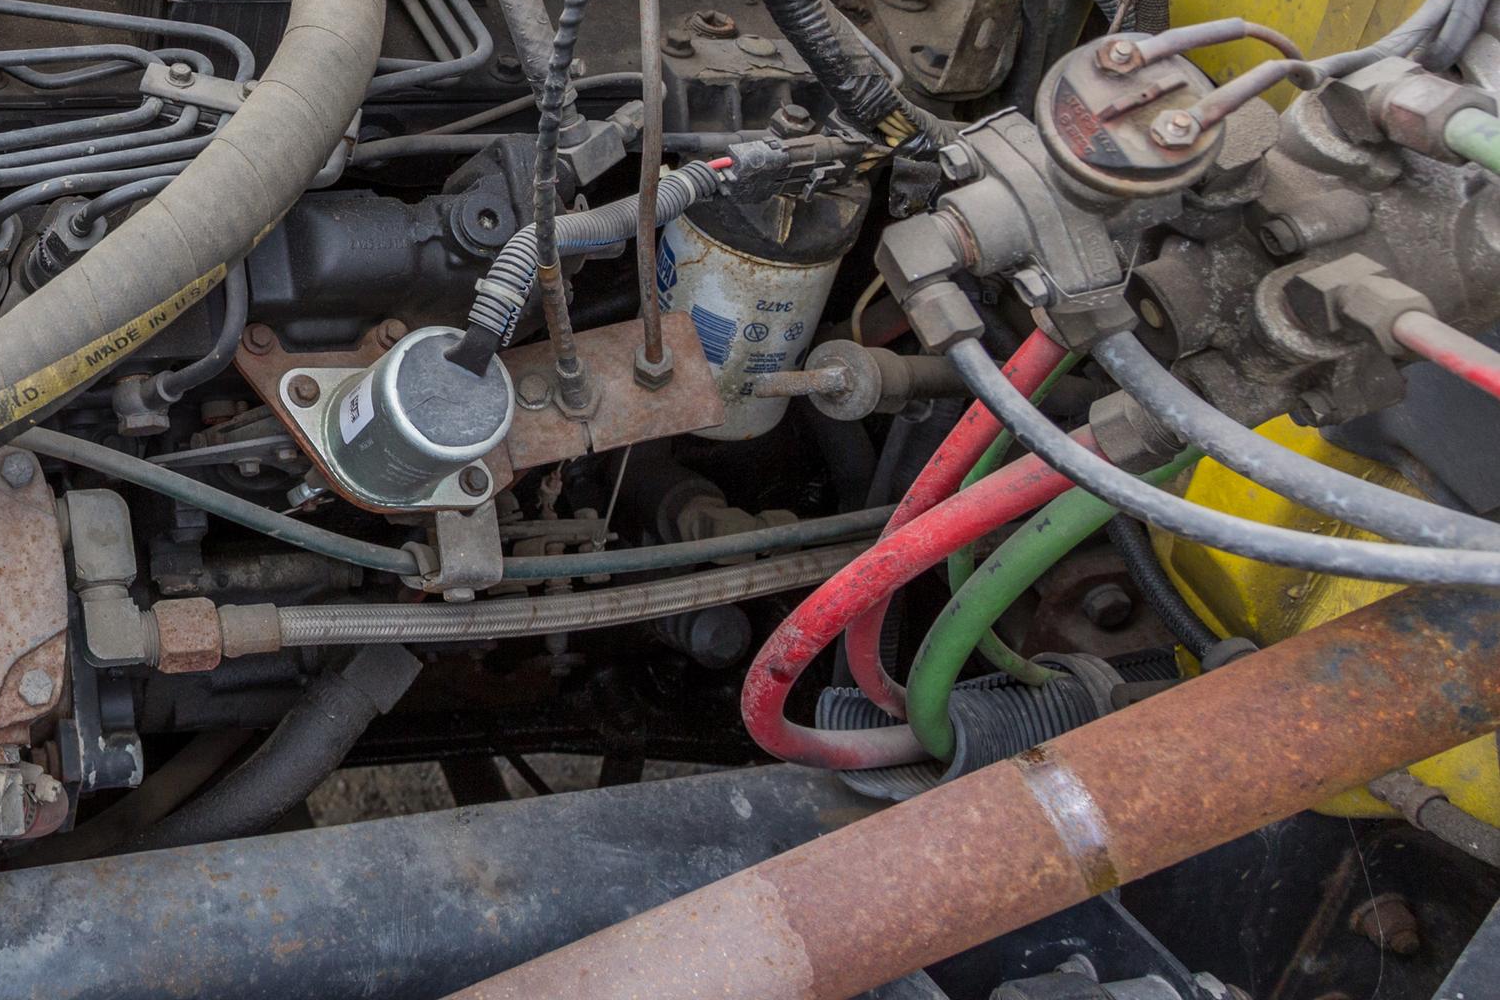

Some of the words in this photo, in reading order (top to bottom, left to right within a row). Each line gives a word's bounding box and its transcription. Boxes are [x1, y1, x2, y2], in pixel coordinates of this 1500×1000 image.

[756, 299, 794, 314] 3472
[84, 329, 143, 367] MADE
[148, 311, 168, 329] IN
